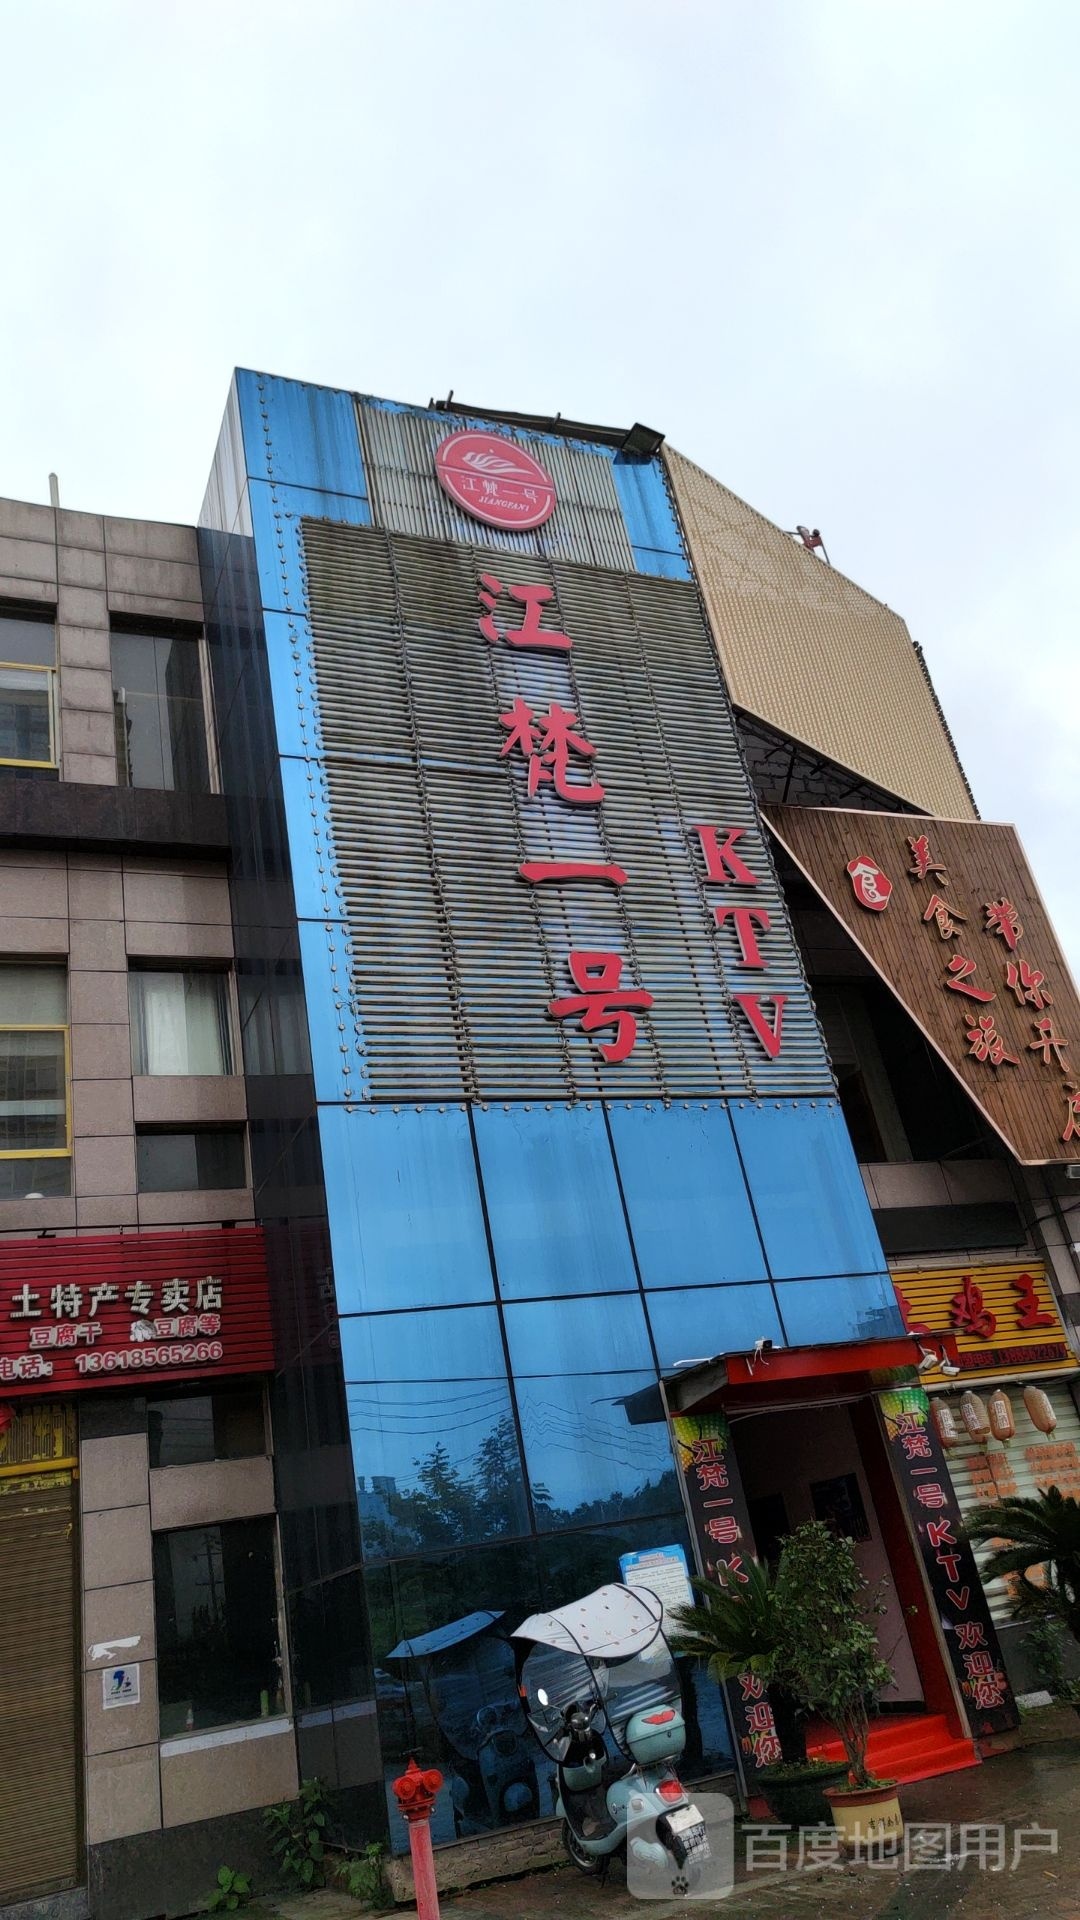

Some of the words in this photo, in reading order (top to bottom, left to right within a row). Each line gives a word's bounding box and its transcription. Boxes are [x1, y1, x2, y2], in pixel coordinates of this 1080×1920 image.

[478, 572, 655, 1064] 江梵一号
[691, 824, 789, 1059] KTV
[10, 1275, 223, 1319] 土特产专卖店
[29, 1321, 103, 1350] 豆腐干
[75, 1341, 224, 1374] 13618565266
